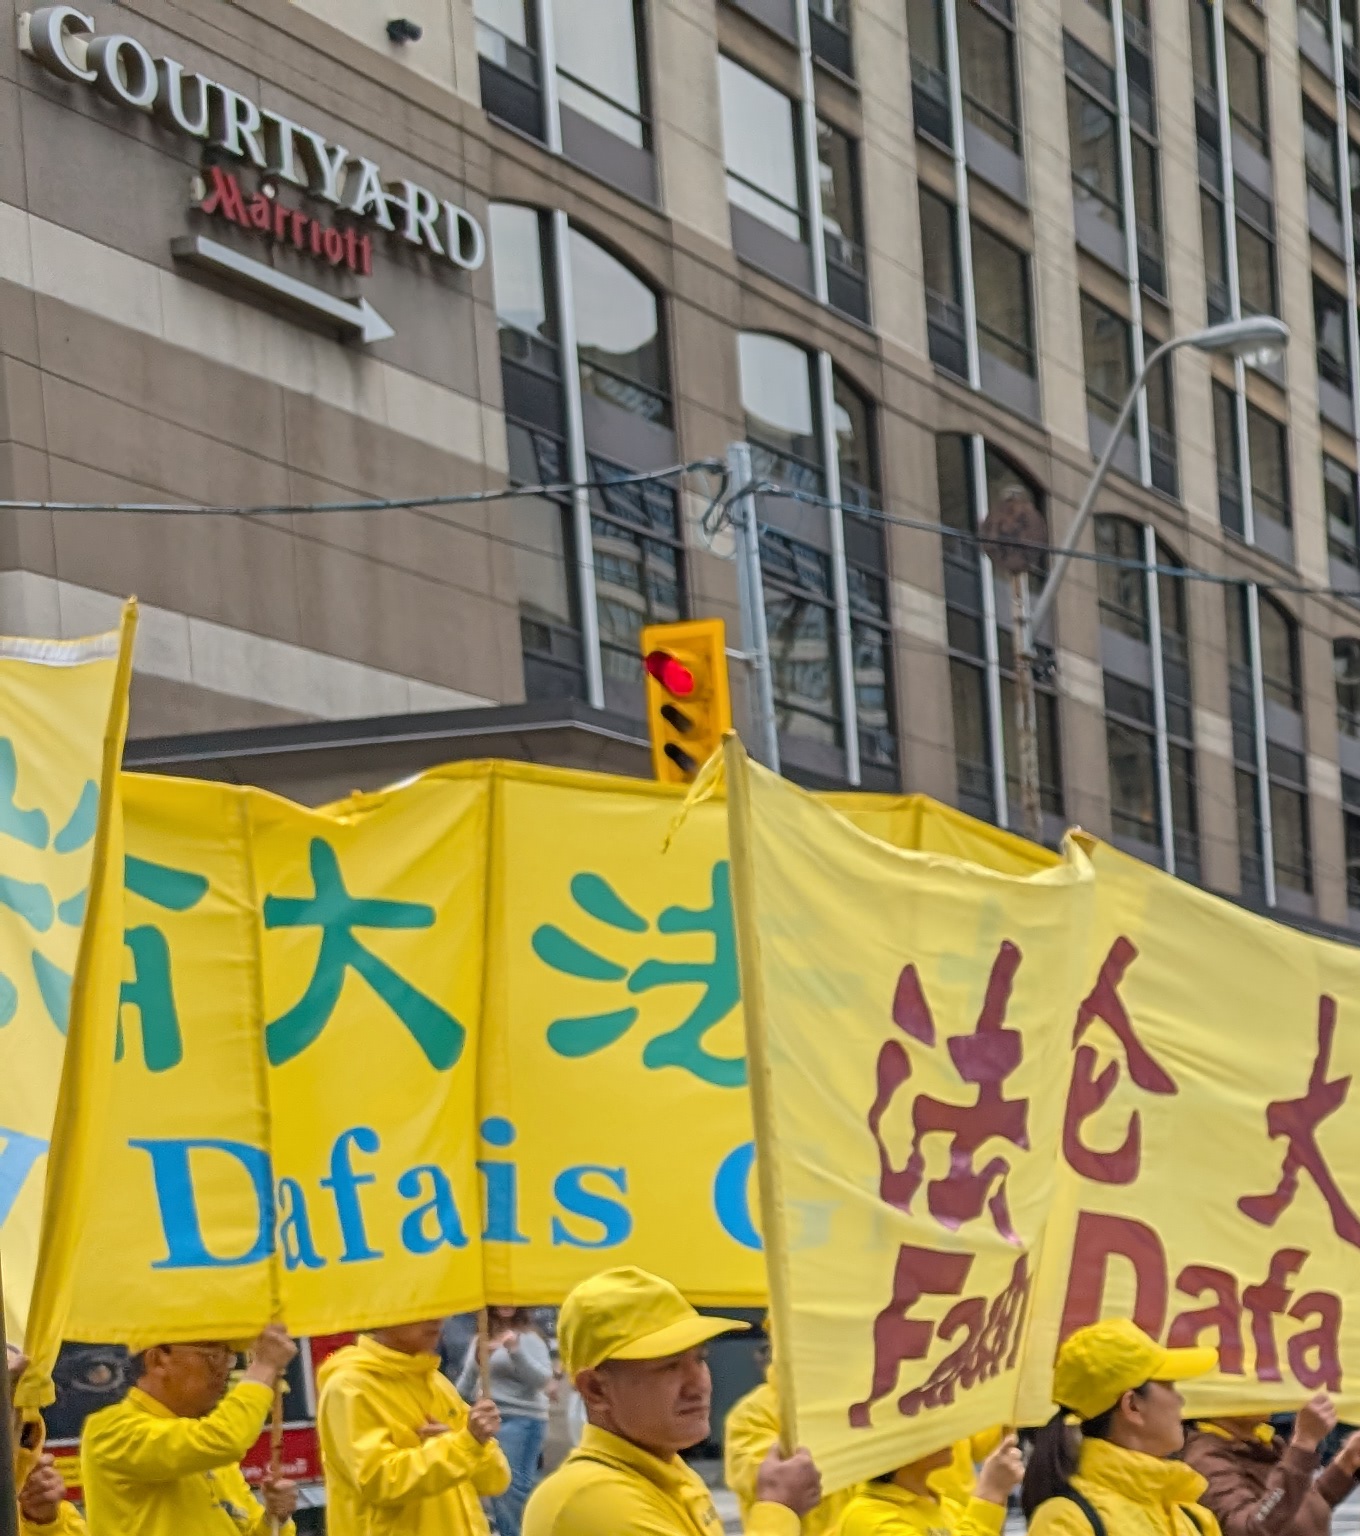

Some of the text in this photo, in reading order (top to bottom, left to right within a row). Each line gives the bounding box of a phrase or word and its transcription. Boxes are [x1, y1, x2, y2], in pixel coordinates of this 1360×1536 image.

[29, 4, 486, 271] COURTYARD
[202, 166, 373, 276] Marriott
[1053, 1209, 1343, 1394] Dafa
